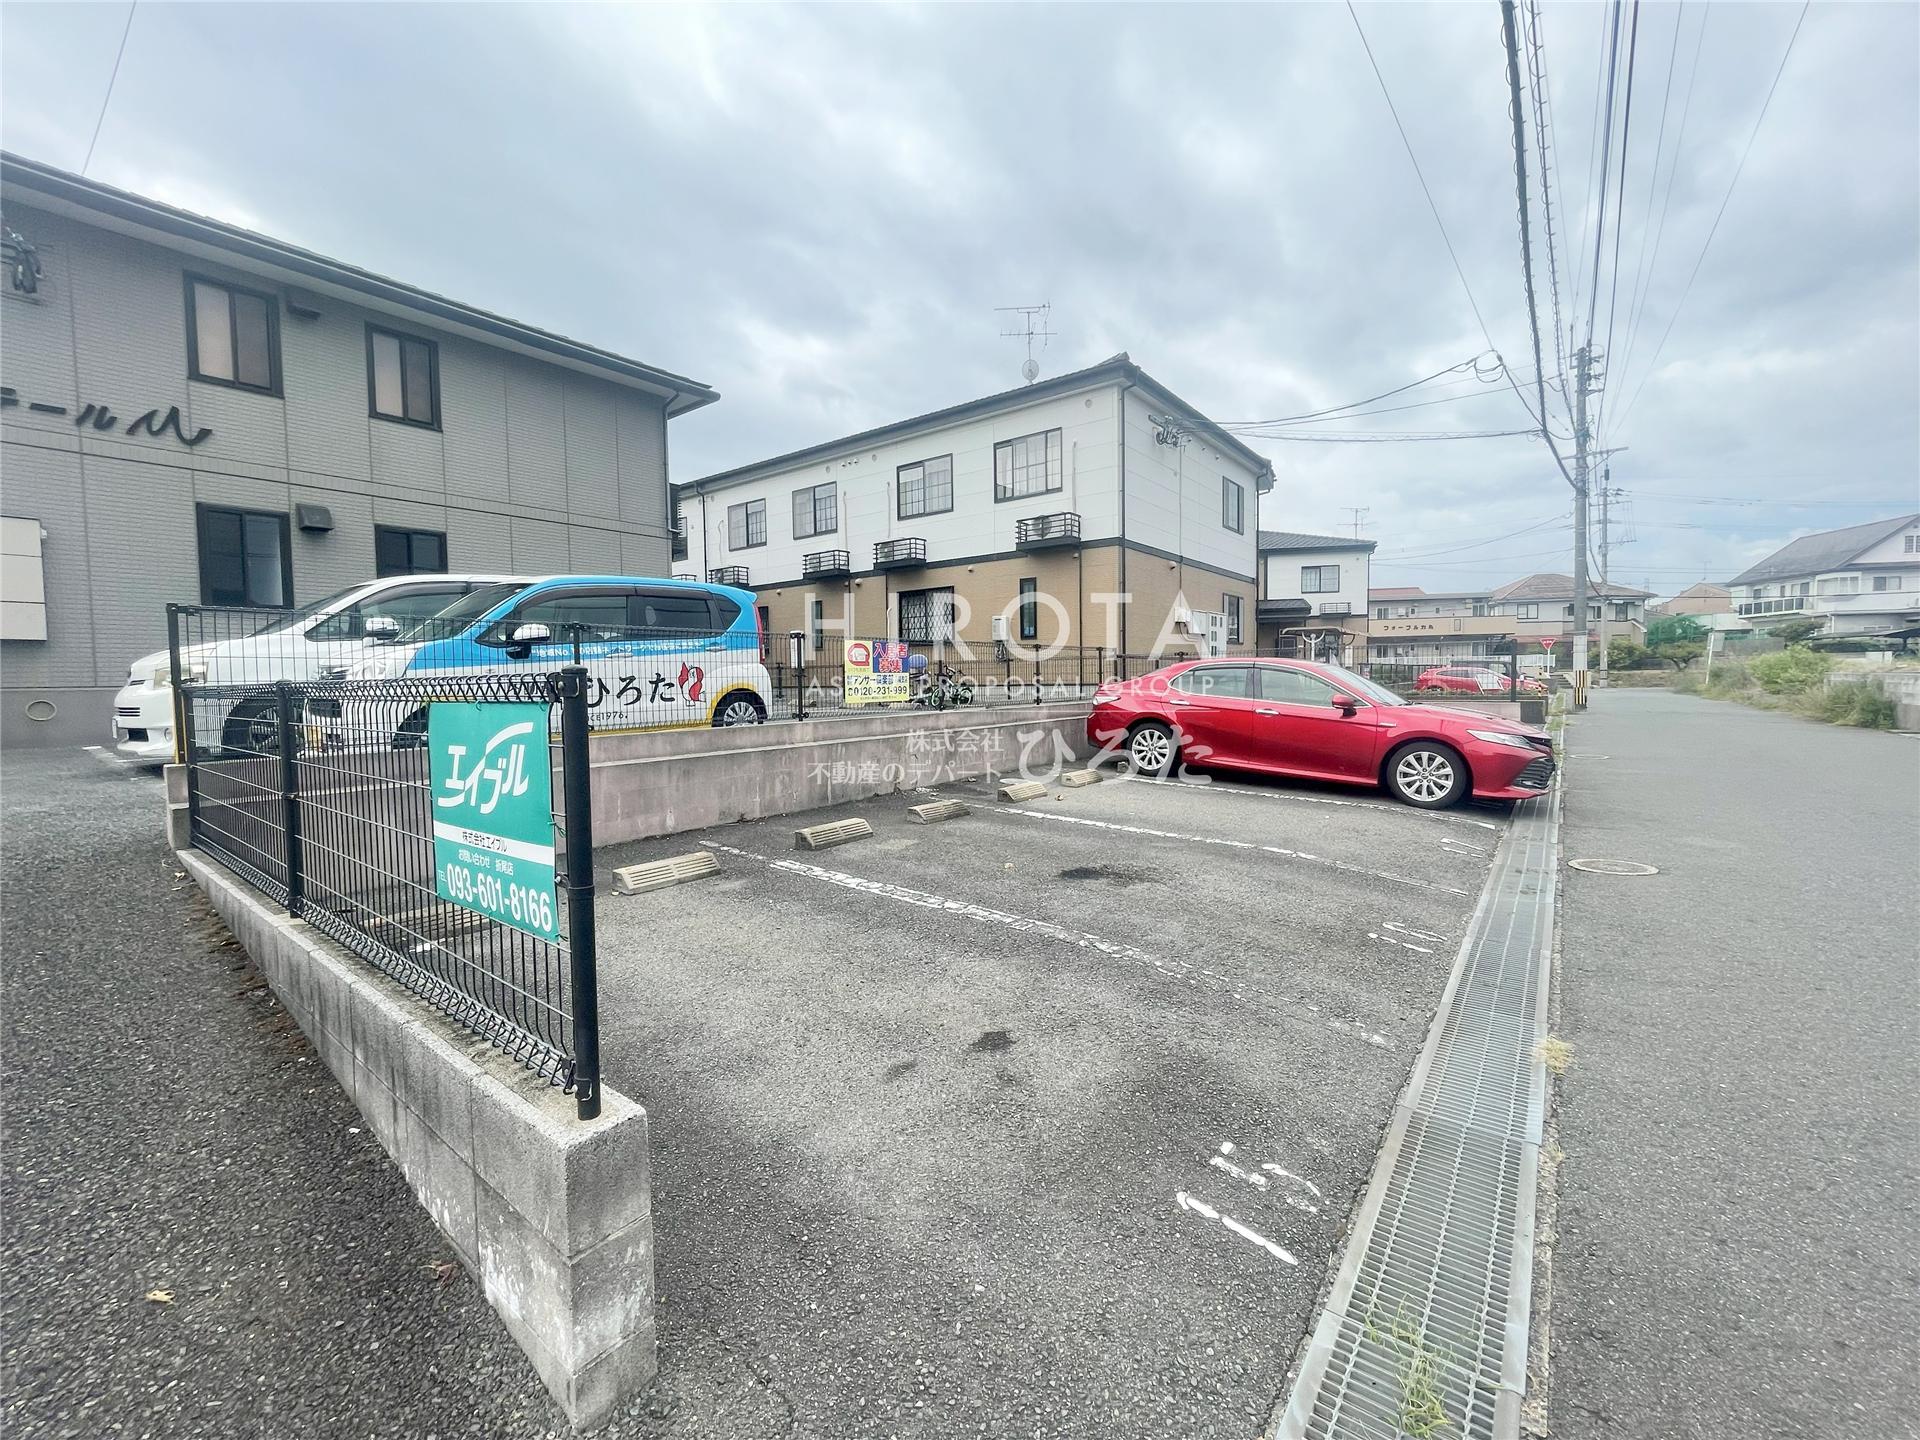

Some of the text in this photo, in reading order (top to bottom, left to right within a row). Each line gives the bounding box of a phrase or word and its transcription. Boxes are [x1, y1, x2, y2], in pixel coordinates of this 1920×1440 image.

[873, 642, 908, 658] 入居者
[854, 686, 907, 695] 0120-231-999
[437, 721, 534, 814] エイブル
[446, 862, 553, 933] 093-601-8166
